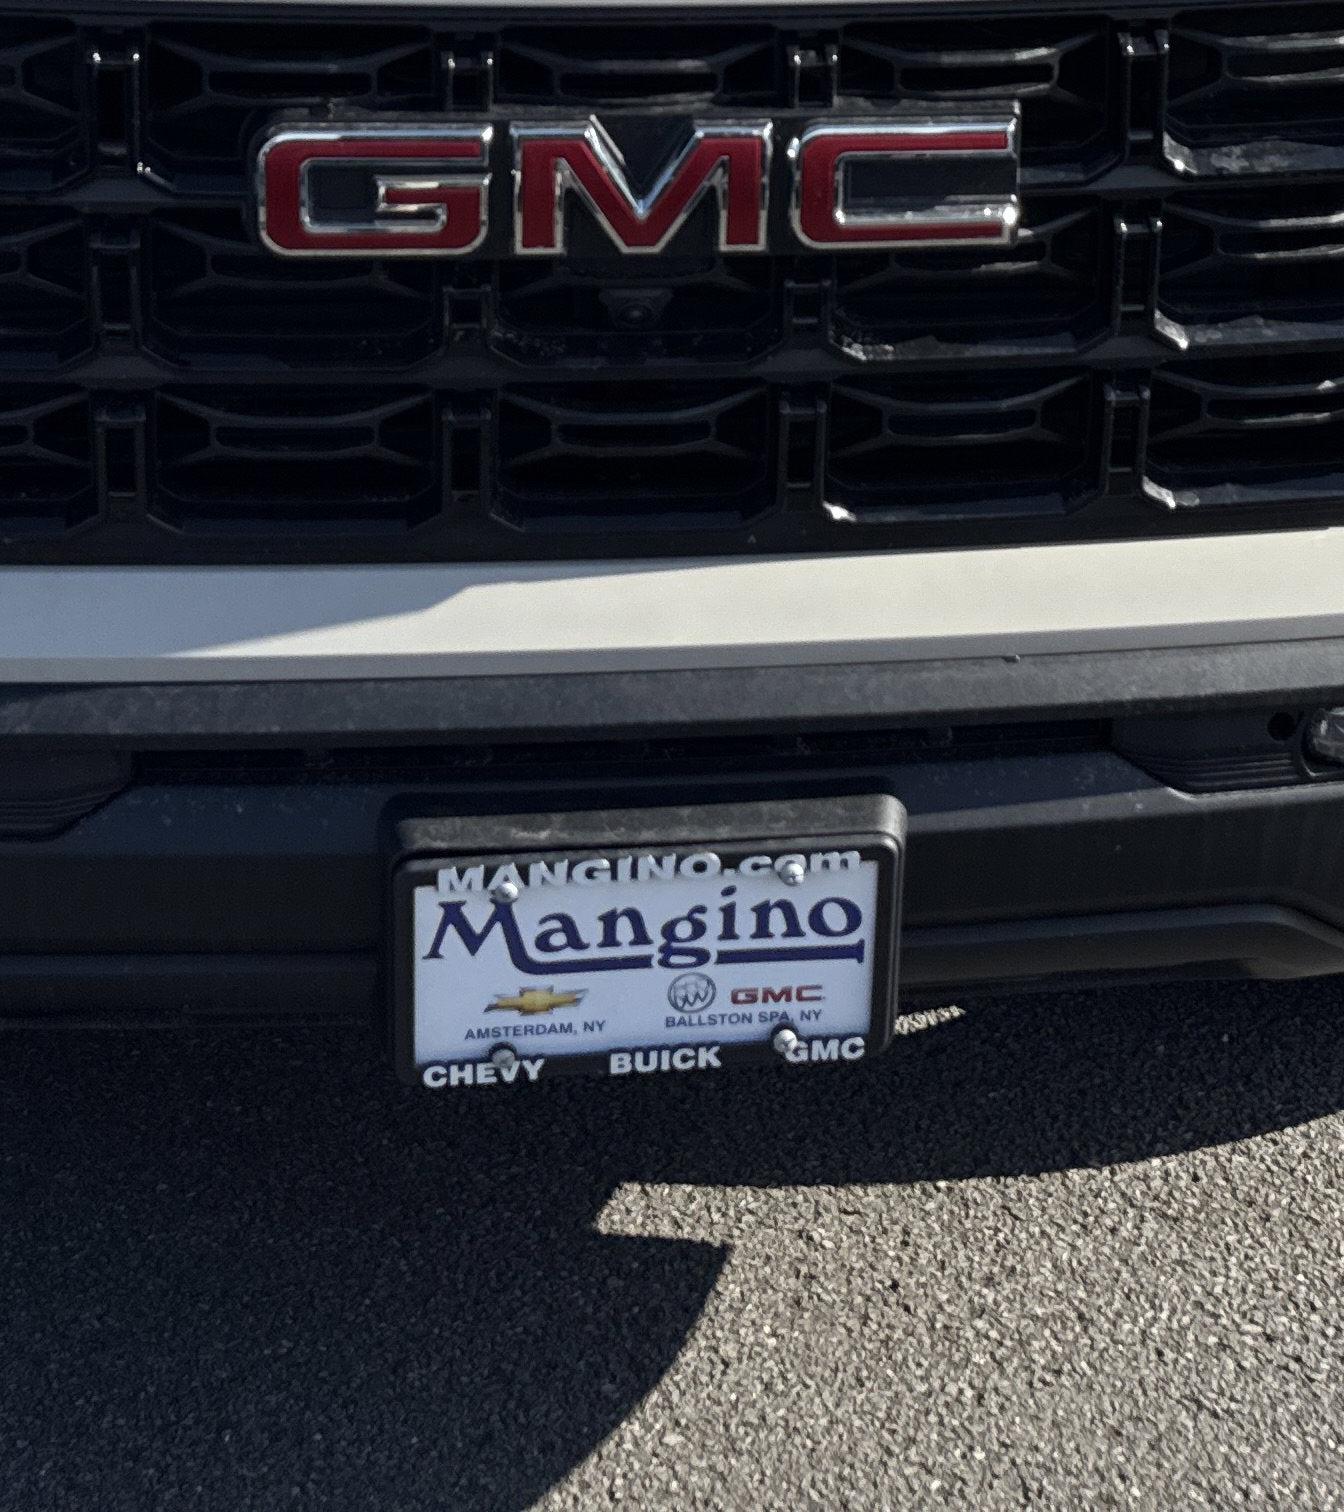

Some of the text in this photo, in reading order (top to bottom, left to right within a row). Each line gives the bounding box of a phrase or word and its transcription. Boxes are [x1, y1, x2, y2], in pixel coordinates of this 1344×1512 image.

[258, 104, 1022, 256] GMC
[422, 885, 865, 975] Mangino
[730, 984, 823, 1005] GMC
[464, 1019, 607, 1041] AMSTERDAM, NY
[665, 1012, 754, 1029] BALLSTON
[799, 1008, 823, 1022] NY
[422, 1036, 866, 1089] CHEVY BUICK GMC
